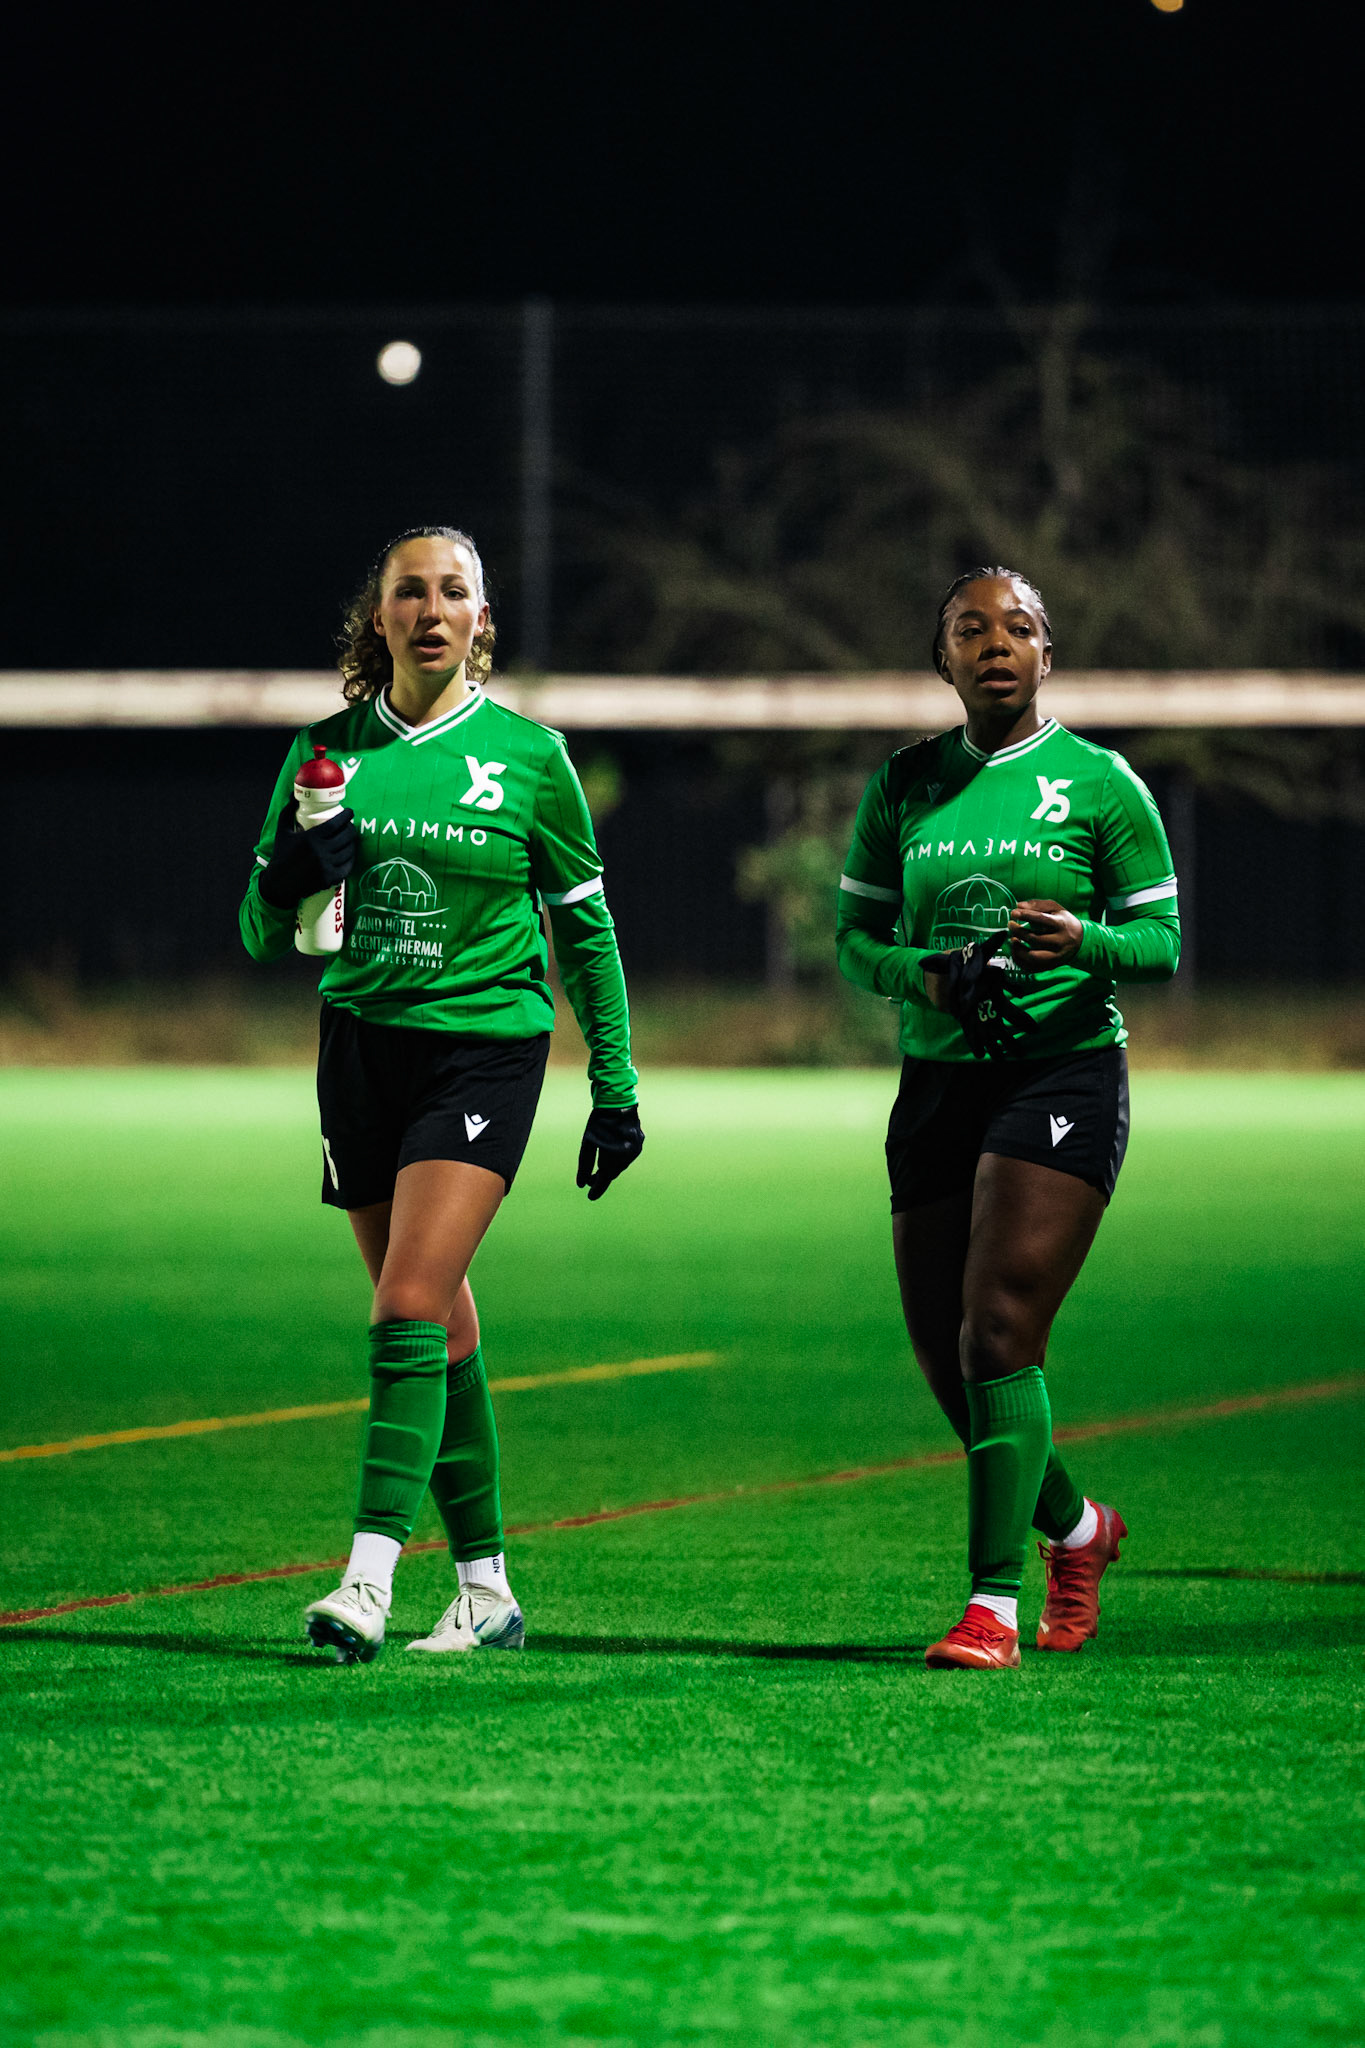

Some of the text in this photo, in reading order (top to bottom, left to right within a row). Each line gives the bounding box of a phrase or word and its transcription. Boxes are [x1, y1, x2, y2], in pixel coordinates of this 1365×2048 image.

[386, 915, 416, 935] HÔTEL
[350, 934, 443, 958] & CENTRE THERMAL
